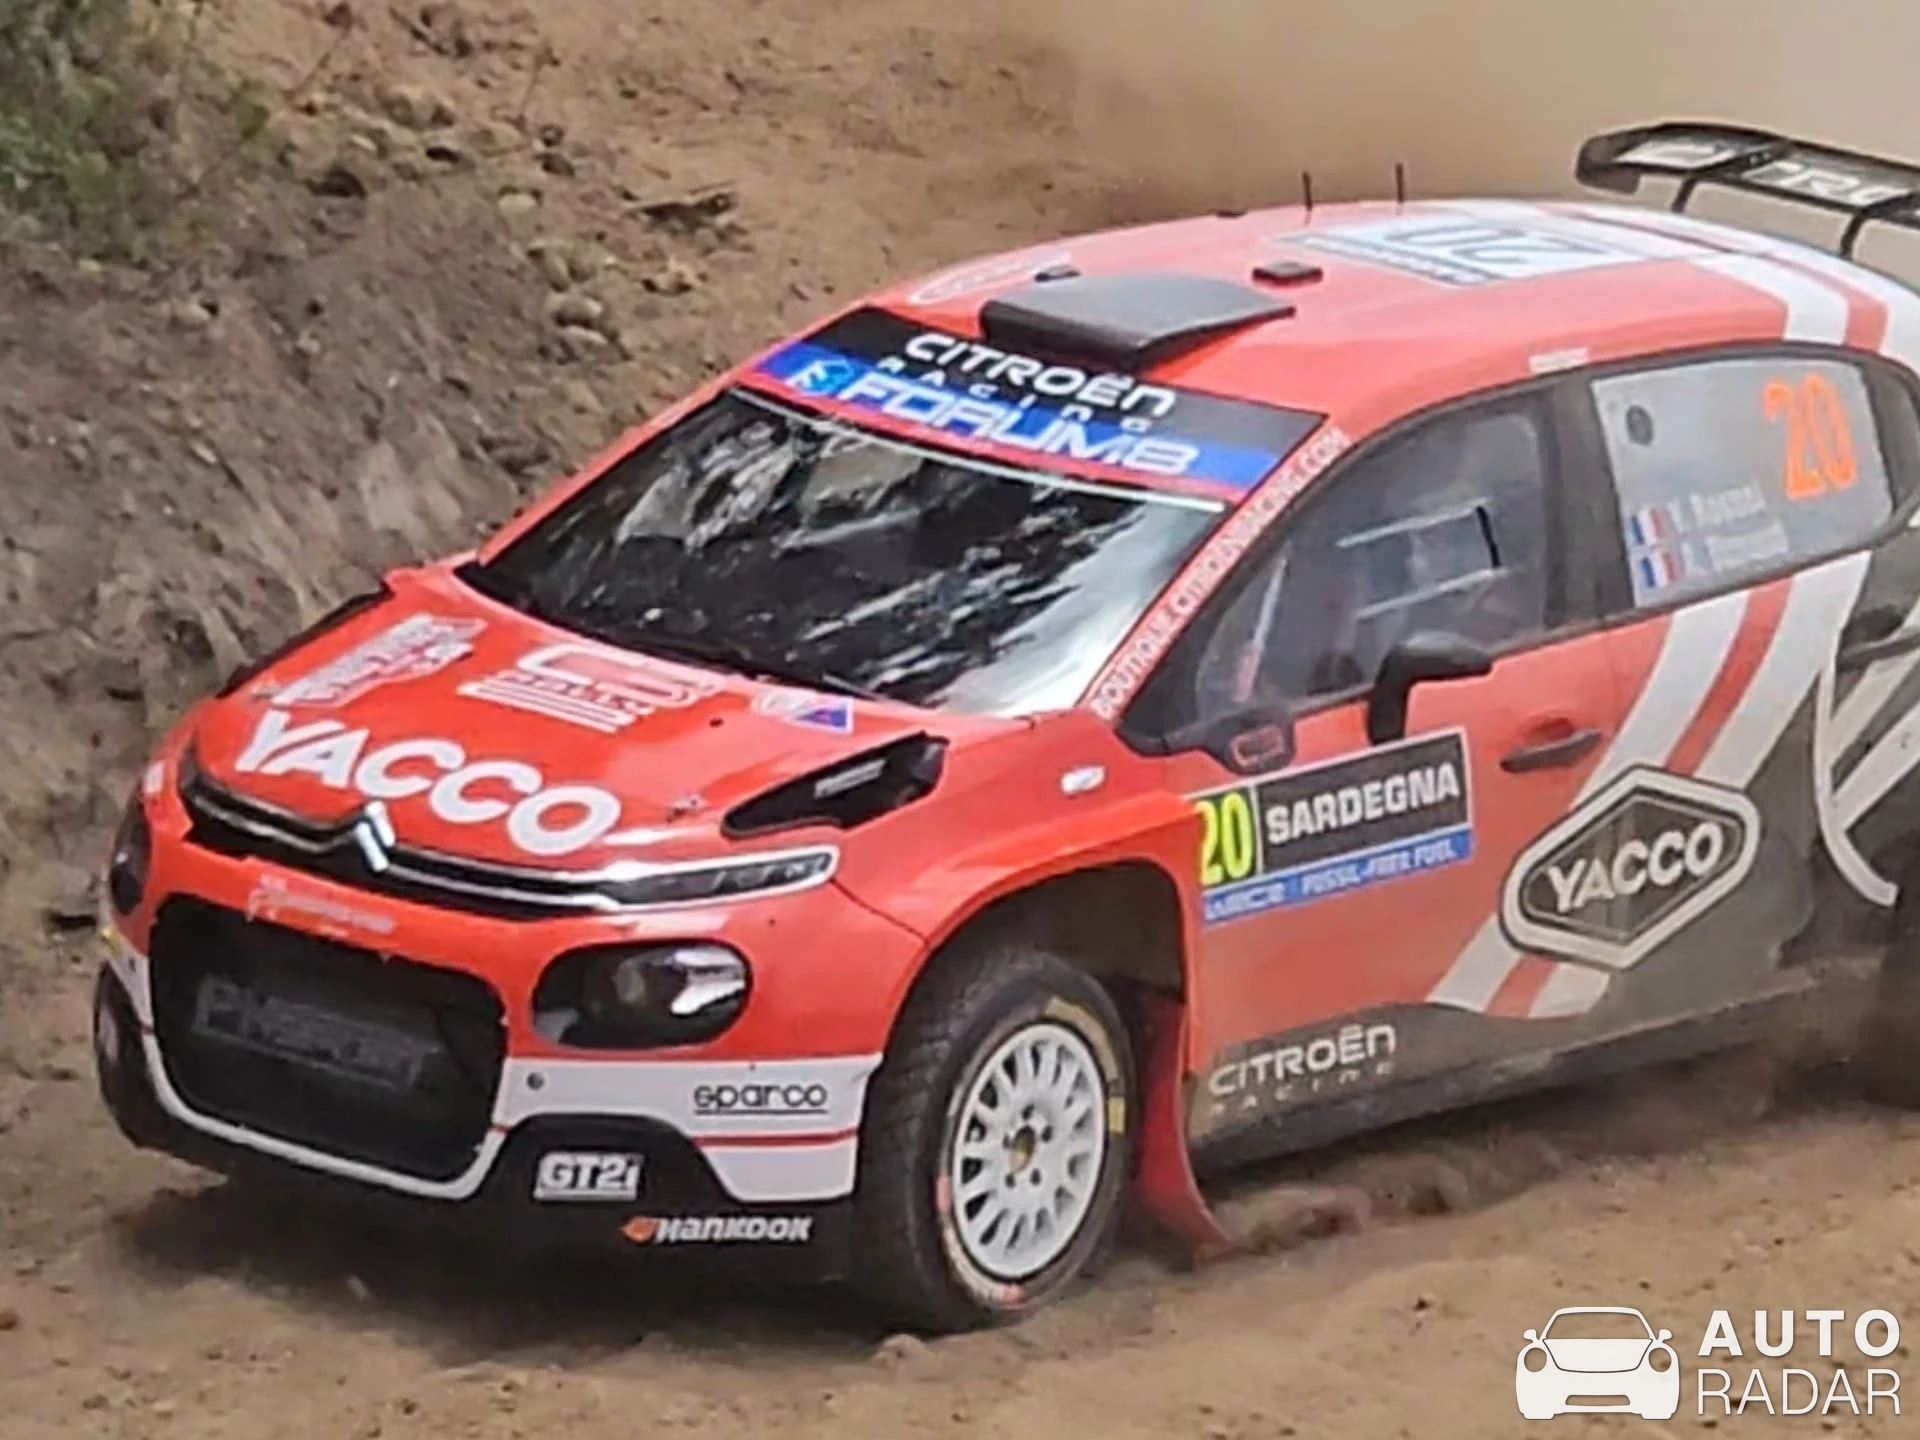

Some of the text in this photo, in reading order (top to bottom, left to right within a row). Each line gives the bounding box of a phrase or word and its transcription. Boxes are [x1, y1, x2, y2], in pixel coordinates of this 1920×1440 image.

[876, 355, 1153, 435] RACING
[905, 333, 1177, 417] CITROËN
[839, 370, 1200, 476] FORUM8
[1761, 371, 1858, 502] 20
[233, 710, 622, 856] YACCO
[1265, 763, 1461, 845] SARDEGNA
[1195, 791, 1254, 887] 20
[1546, 822, 1725, 914] YACCO
[693, 1084, 828, 1111] sparco
[1208, 1023, 1397, 1096] CITROËN
